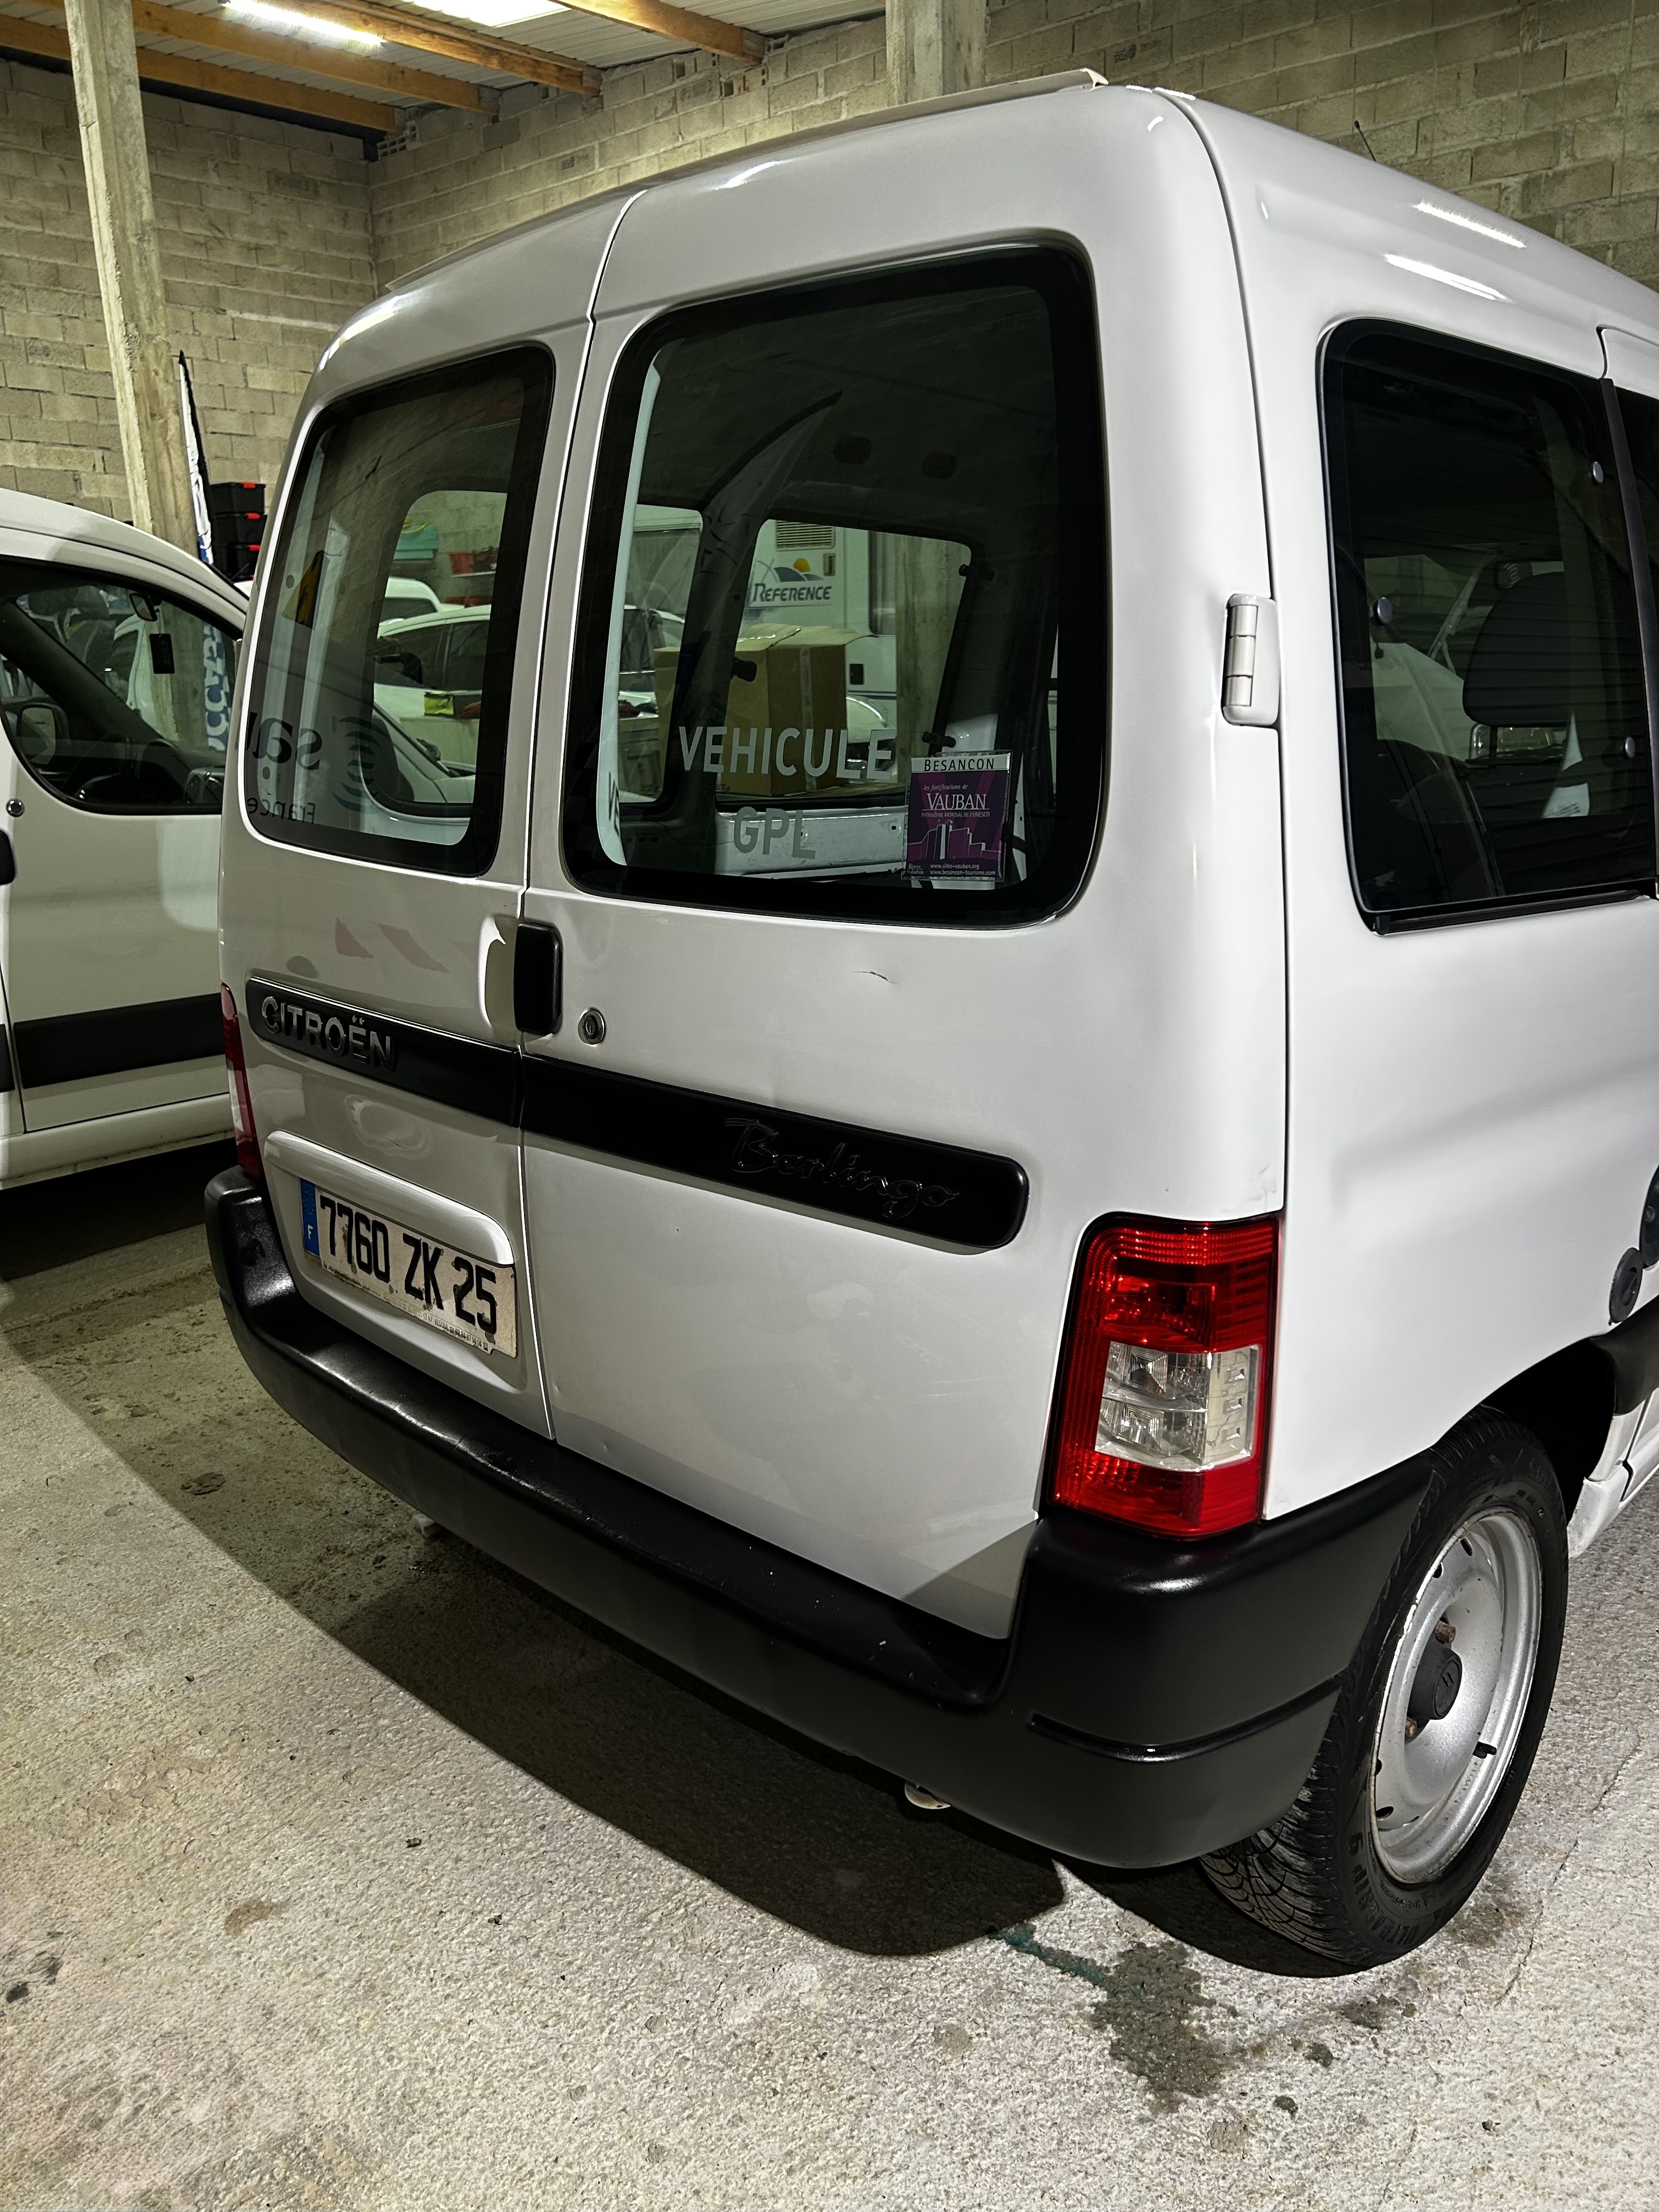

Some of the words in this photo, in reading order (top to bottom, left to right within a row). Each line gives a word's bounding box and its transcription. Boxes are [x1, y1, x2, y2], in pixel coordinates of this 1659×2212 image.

[752, 583, 832, 602] REFERENCE
[678, 725, 897, 781] VEHICULE
[926, 793, 988, 810] VAUBAN
[733, 806, 816, 859] GPL
[261, 996, 393, 1070] CITROËN
[725, 1118, 960, 1218] Berlingo
[307, 1223, 313, 1241] F
[320, 1195, 390, 1284] 7760
[402, 1232, 444, 1310] ZK
[453, 1256, 497, 1335] 25
